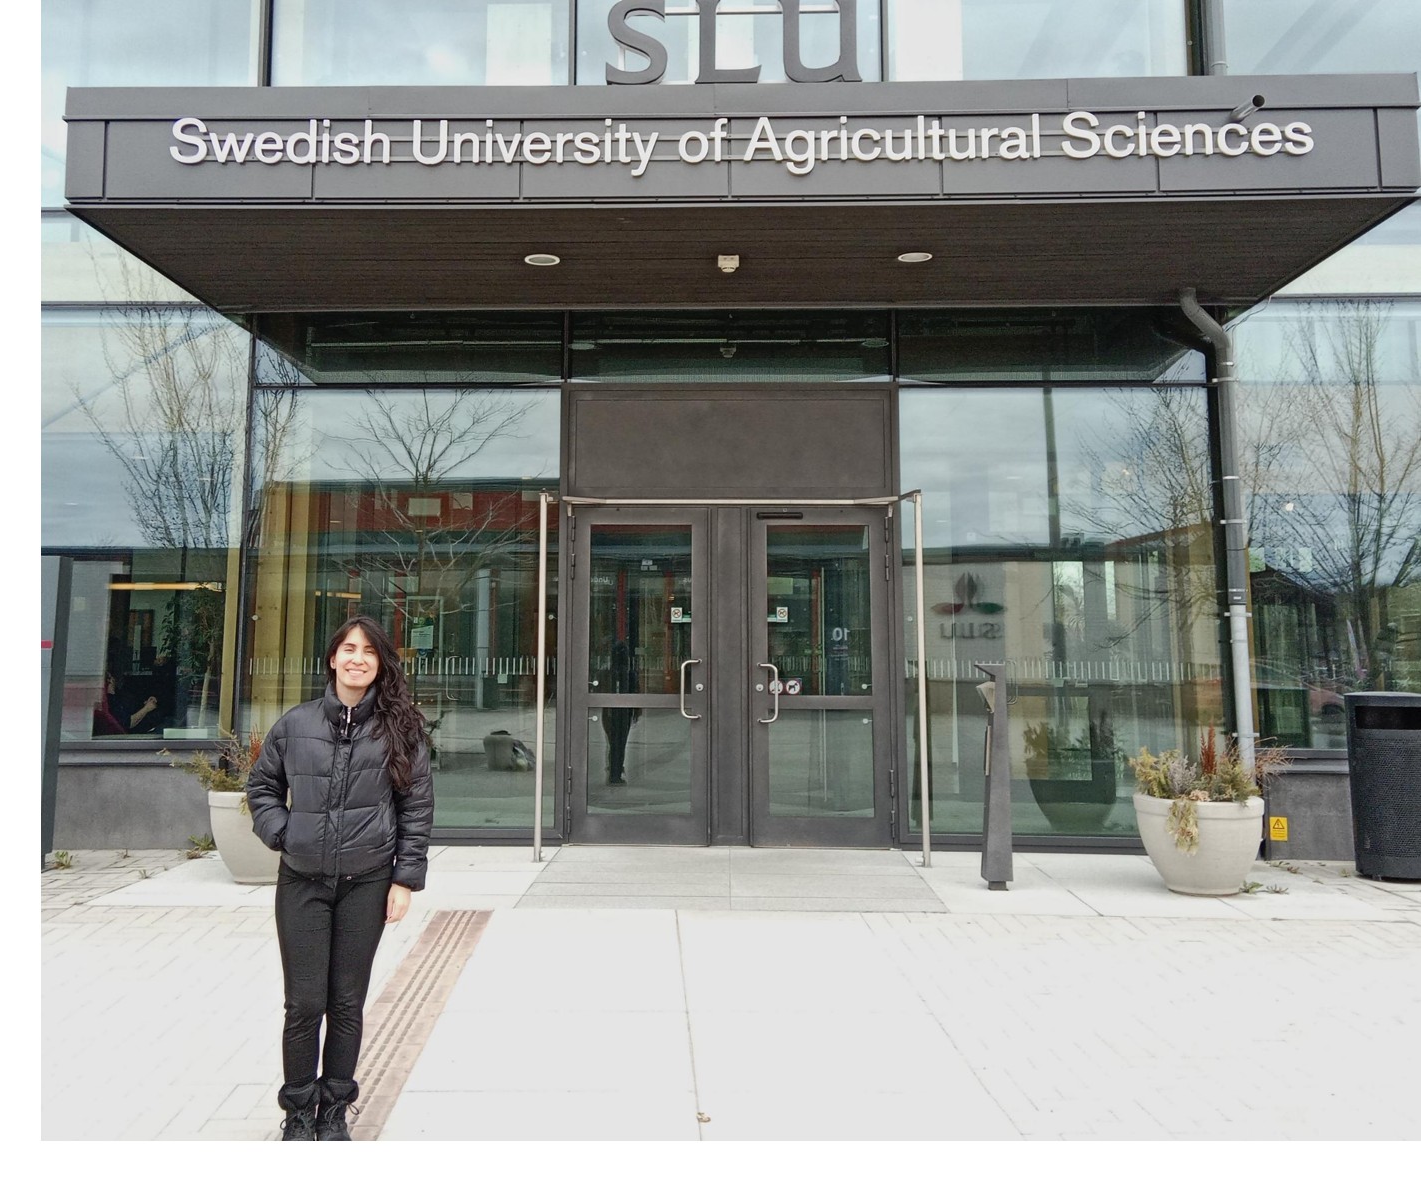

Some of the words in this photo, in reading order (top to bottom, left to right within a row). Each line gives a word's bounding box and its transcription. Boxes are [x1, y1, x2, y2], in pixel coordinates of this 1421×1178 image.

[169, 117, 391, 165] Swedish
[412, 118, 660, 177] University
[678, 117, 730, 165] of
[743, 113, 1042, 176] Agricultural
[1060, 111, 1315, 160] Sciences
